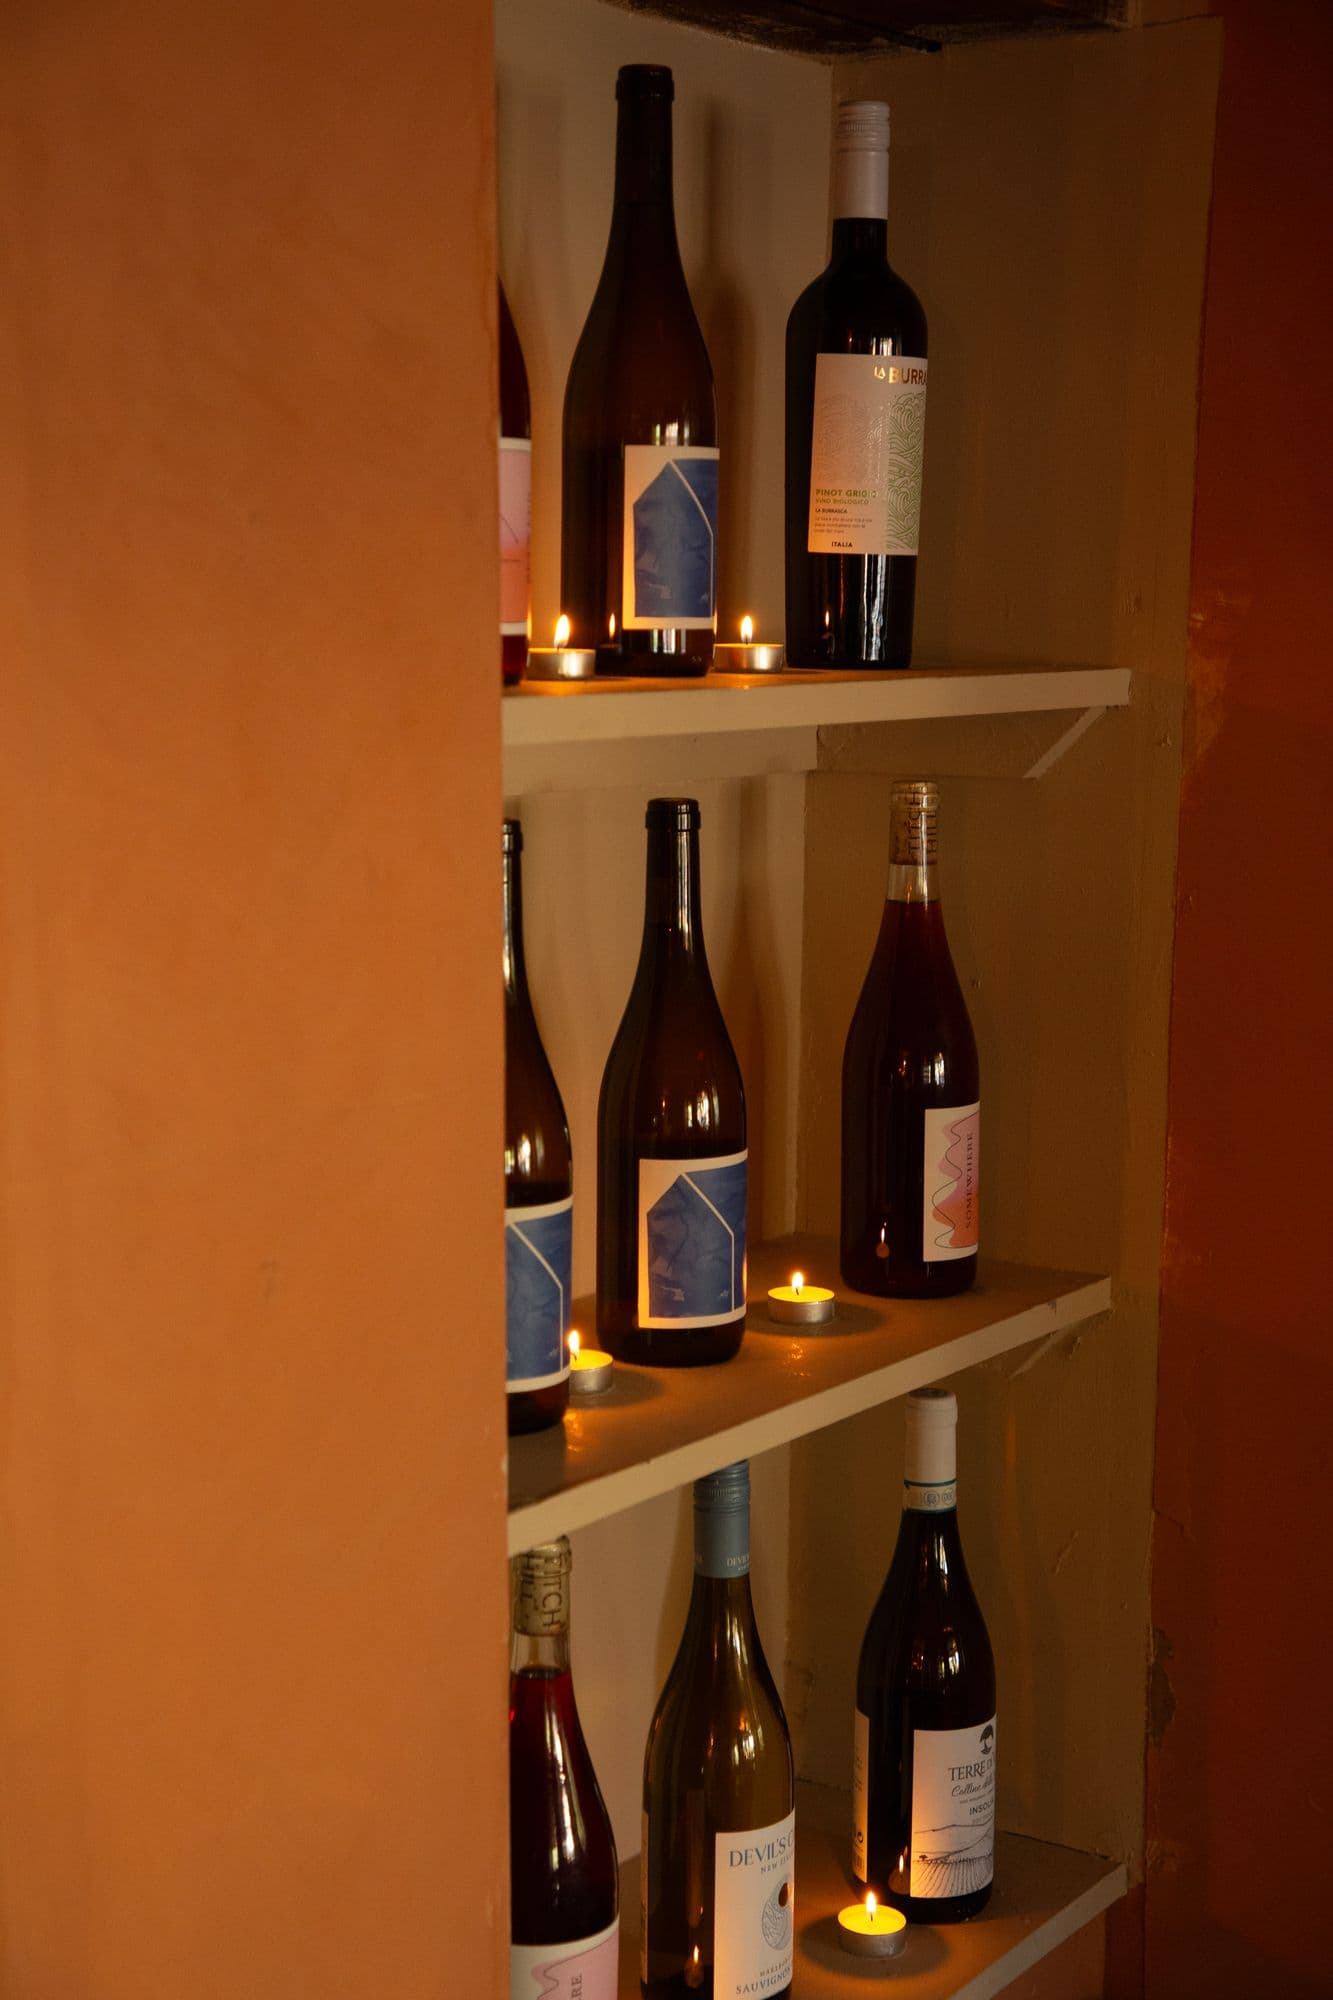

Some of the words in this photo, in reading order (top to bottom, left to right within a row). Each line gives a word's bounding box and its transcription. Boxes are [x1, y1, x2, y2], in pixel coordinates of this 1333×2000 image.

[873, 366, 886, 380] LA
[815, 489, 842, 497] PINOT
[966, 1132, 974, 1229] SOMEWHERE
[948, 1760, 986, 1781] TERRE
[729, 1836, 786, 1868] DEVIL'S
